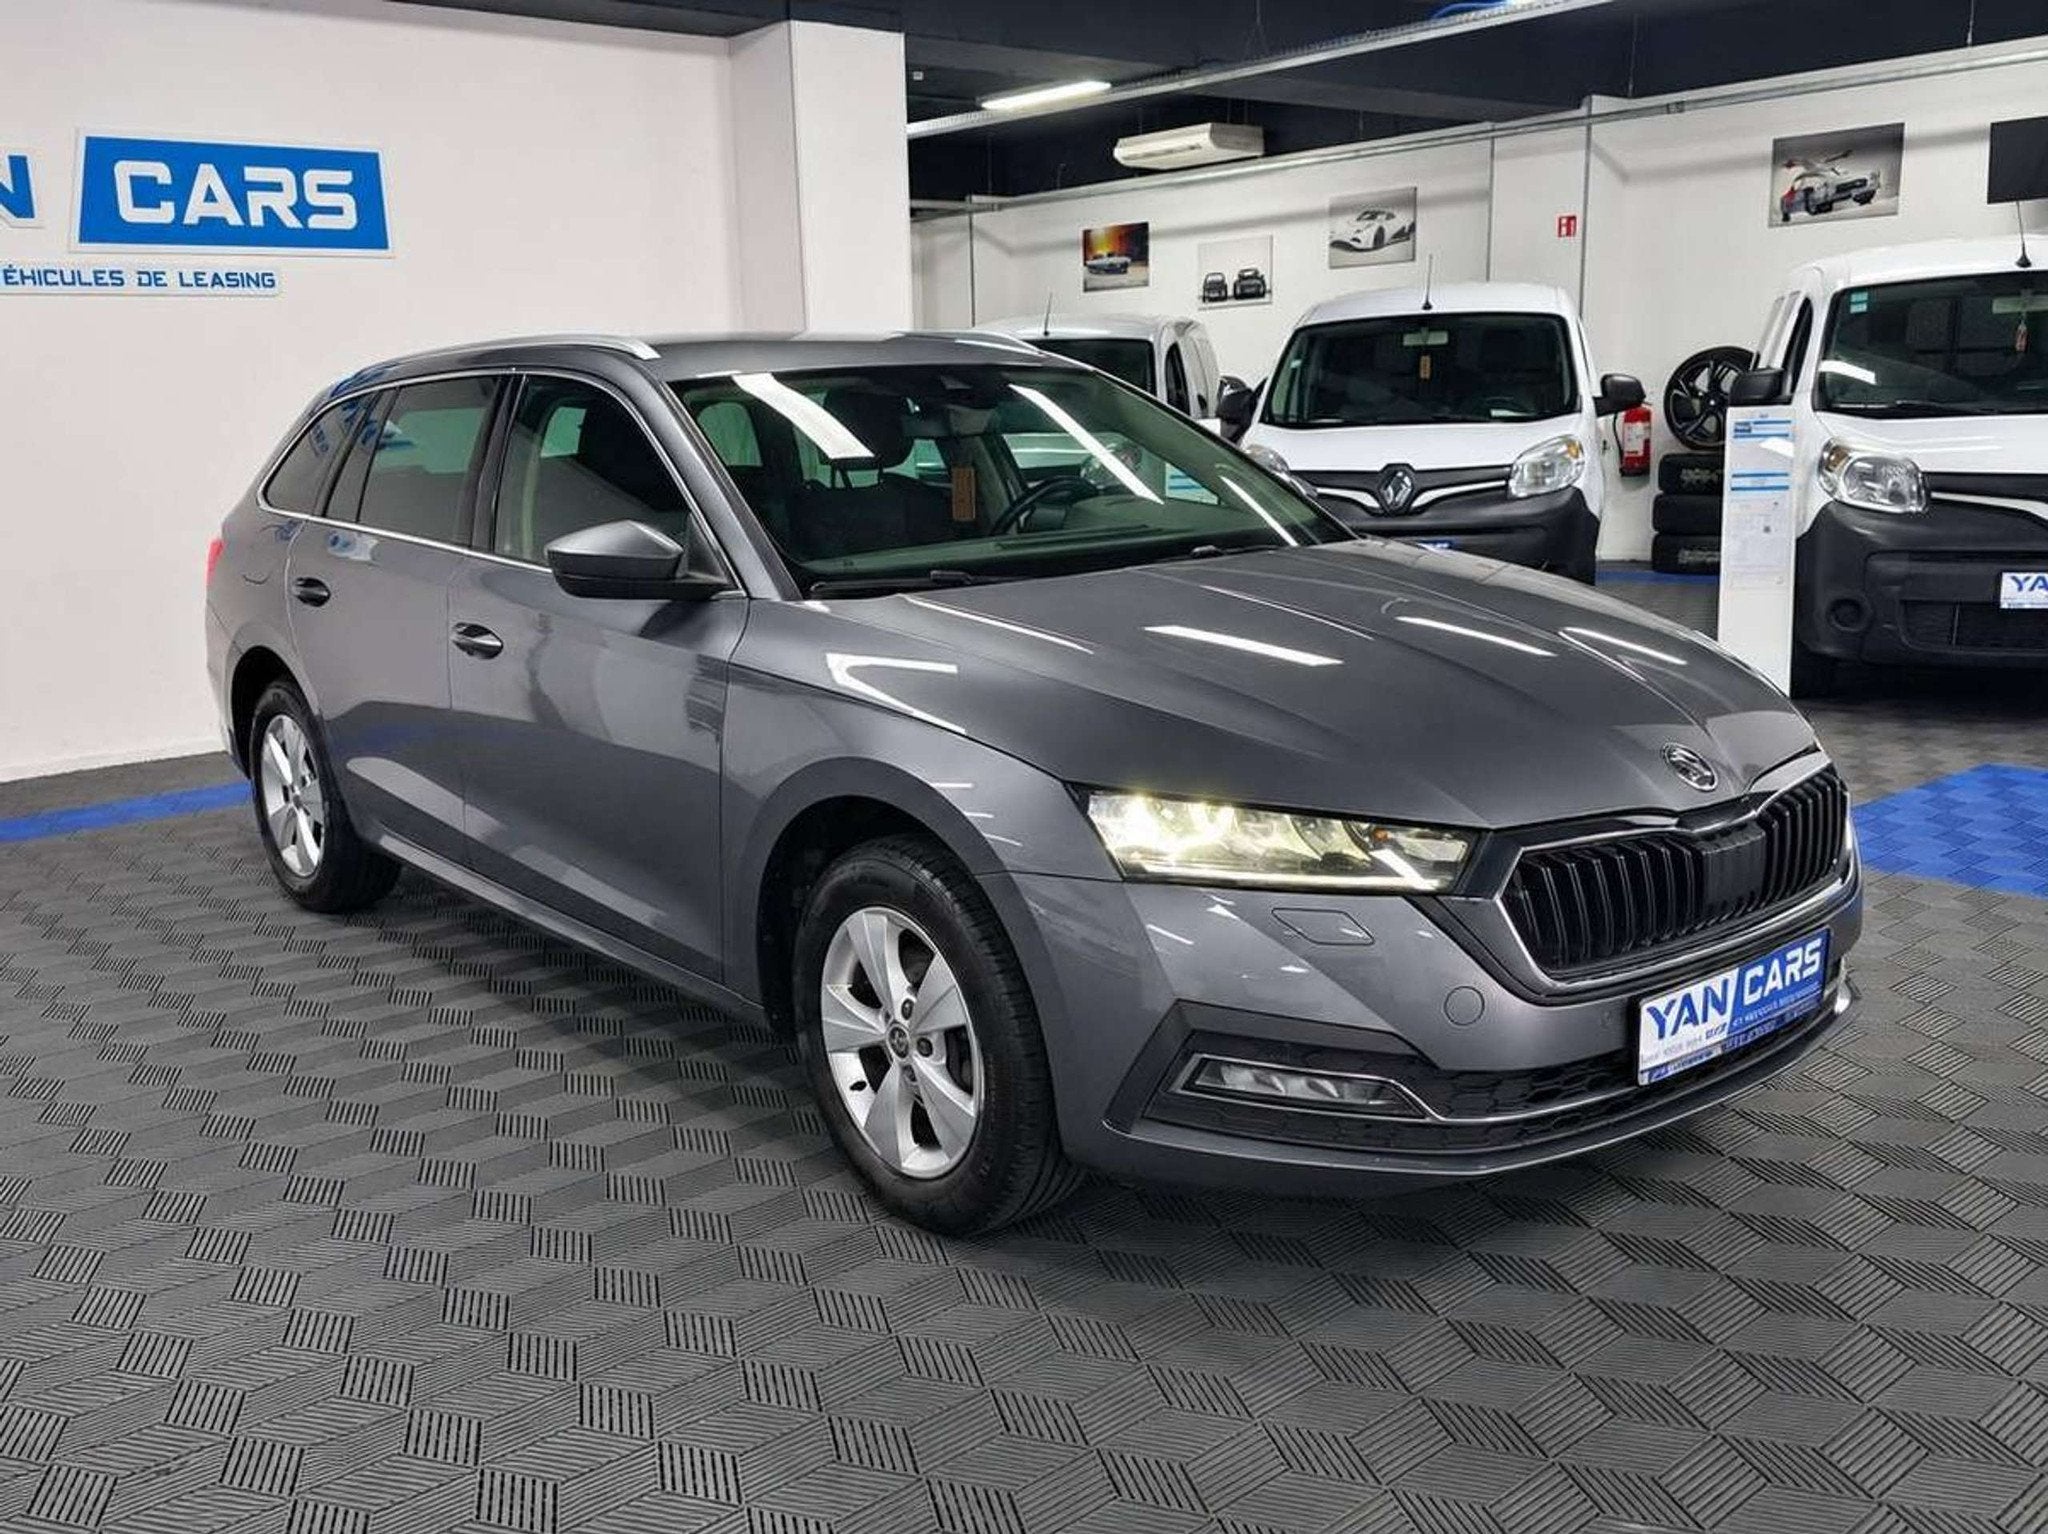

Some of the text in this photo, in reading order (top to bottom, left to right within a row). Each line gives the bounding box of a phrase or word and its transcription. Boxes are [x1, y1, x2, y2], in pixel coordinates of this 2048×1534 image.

[113, 159, 359, 230] CARS
[137, 271, 168, 287] DE
[179, 272, 276, 289] LEASING
[1647, 978, 1729, 1040] YAN
[1743, 938, 1822, 1006] CARS
